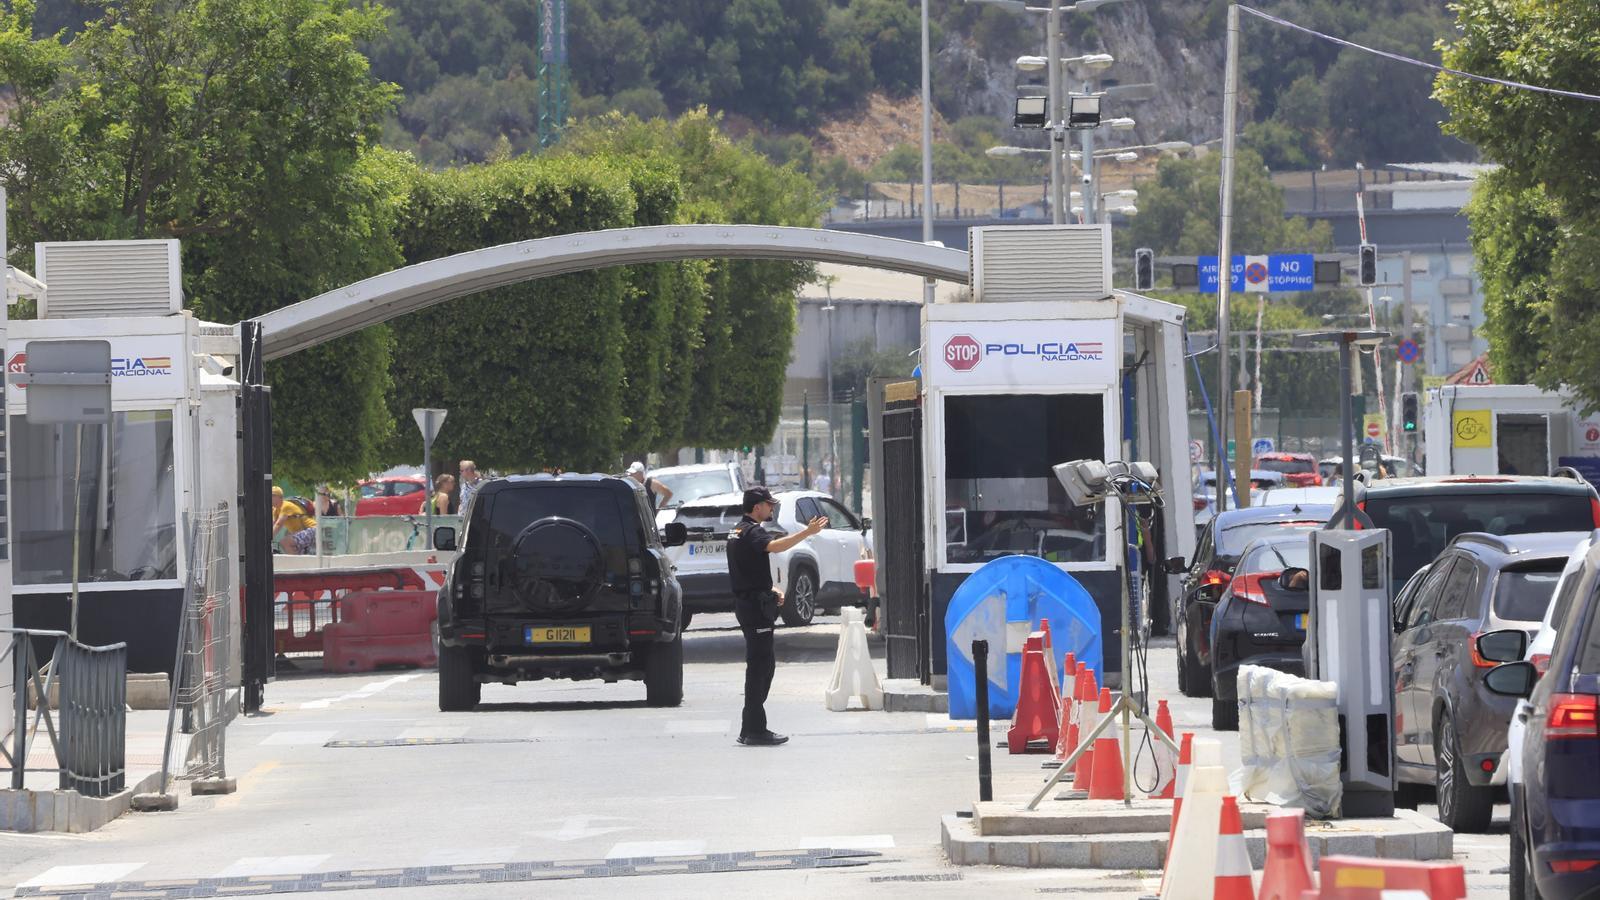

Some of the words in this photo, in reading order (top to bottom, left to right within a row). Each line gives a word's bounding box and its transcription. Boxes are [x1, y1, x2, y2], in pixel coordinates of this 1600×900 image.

[1202, 264, 1244, 272] AIRLD
[1281, 261, 1300, 272] NO
[1208, 275, 1239, 283] AHD
[1269, 276, 1312, 284] STOPPING
[947, 344, 978, 361] STOP
[986, 343, 1078, 355] POLICIA
[11, 362, 26, 374] ST
[111, 369, 172, 377] NACIONAL
[694, 544, 713, 554] 6730
